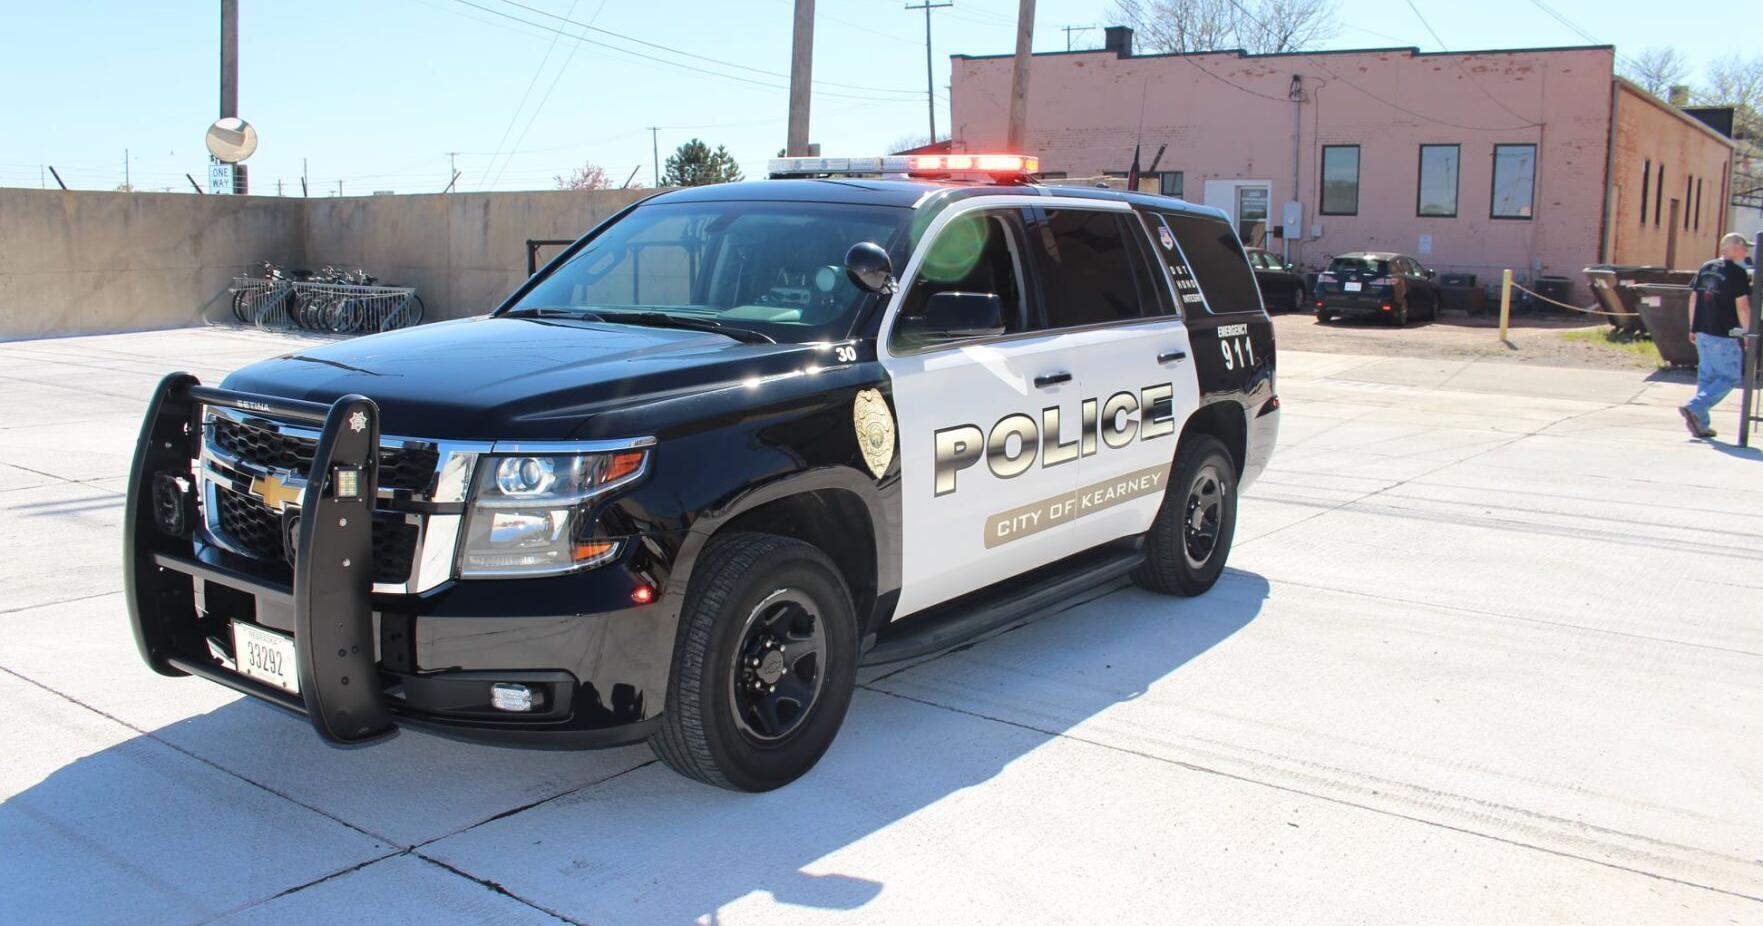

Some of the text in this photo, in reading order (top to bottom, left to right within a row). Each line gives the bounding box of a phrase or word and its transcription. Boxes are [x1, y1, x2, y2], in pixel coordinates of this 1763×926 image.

[212, 167, 229, 177] ONE
[212, 179, 229, 187] WAY
[1170, 265, 1188, 274] DUT
[1176, 279, 1196, 289] HONO
[1217, 323, 1248, 338] EMERGENCY
[835, 346, 857, 362] 30
[1221, 336, 1254, 370] 911
[236, 399, 271, 412] SETINA
[933, 382, 1175, 498] POLICE
[997, 471, 1162, 537] CITY OF KEARNEY
[247, 640, 284, 677] 33292
